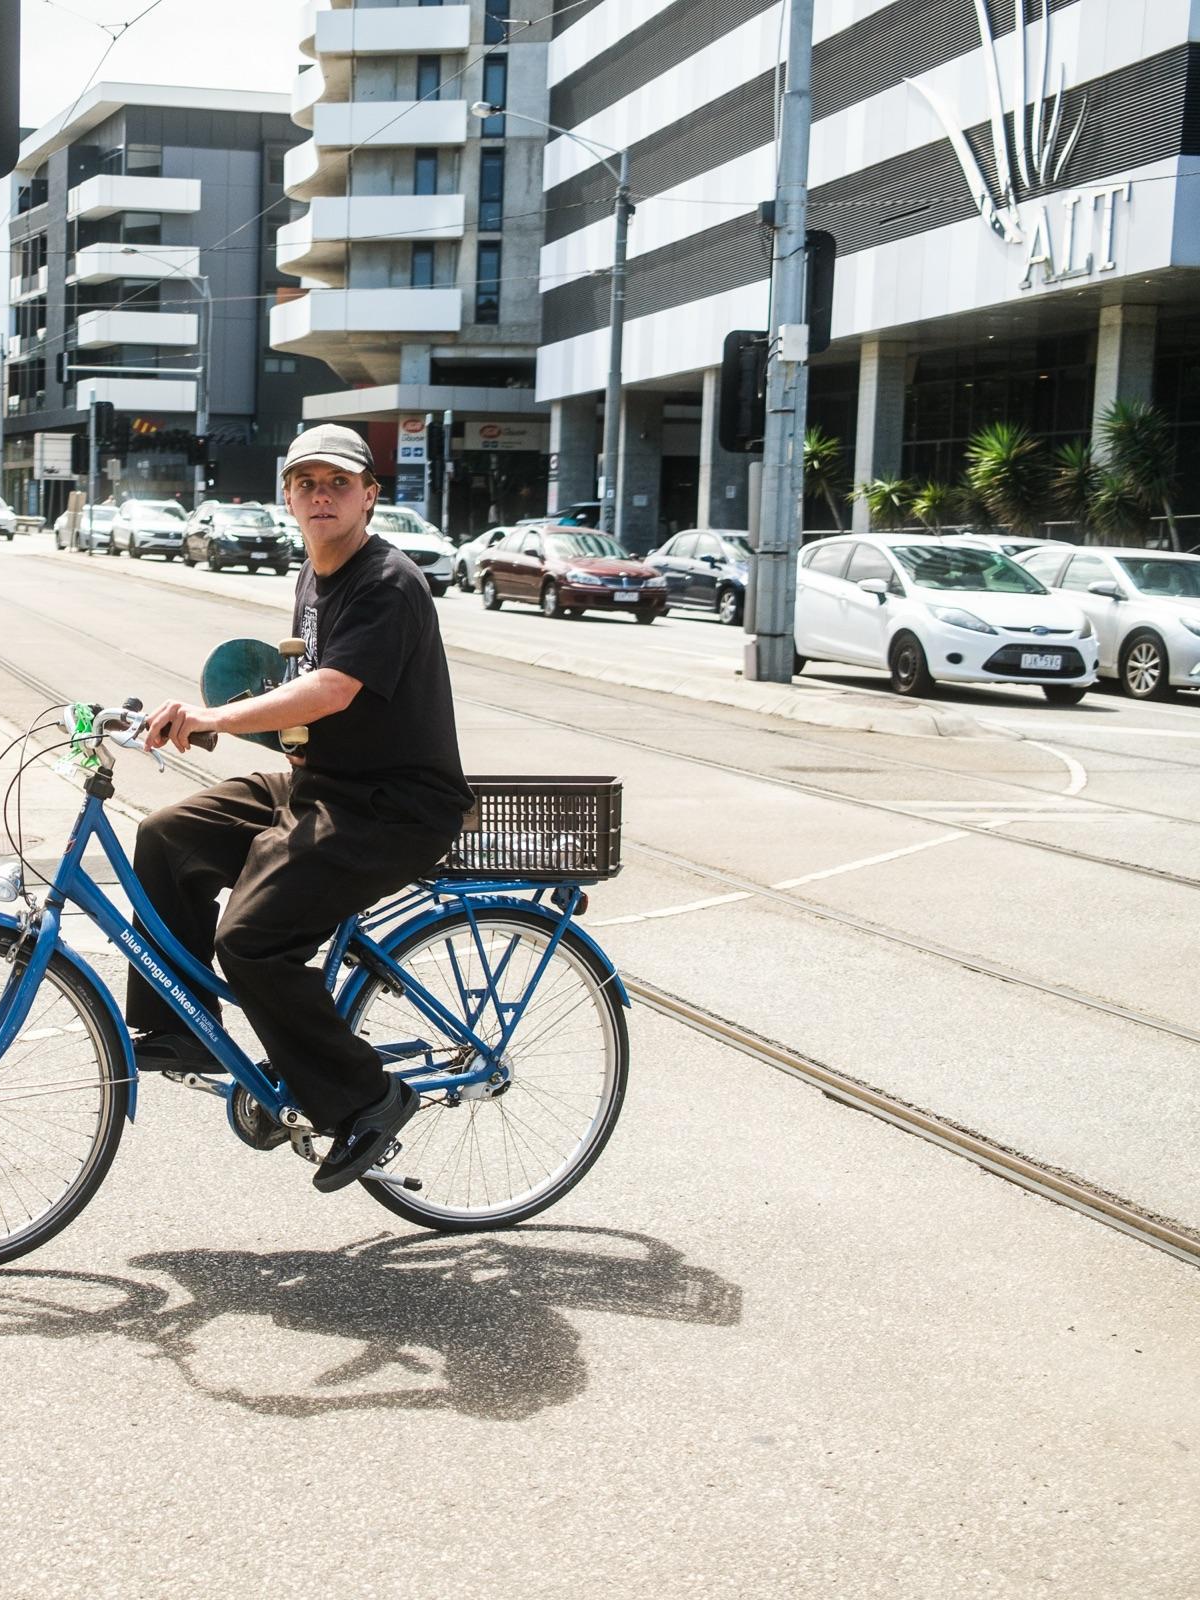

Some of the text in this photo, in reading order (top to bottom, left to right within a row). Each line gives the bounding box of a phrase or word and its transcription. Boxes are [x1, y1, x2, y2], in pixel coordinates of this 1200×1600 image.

[1019, 181, 1132, 290] ALT
[120, 929, 196, 1015] blue tongue bikes
[199, 1021, 218, 1042] RENTALS
[200, 1013, 215, 1031] TOURS
